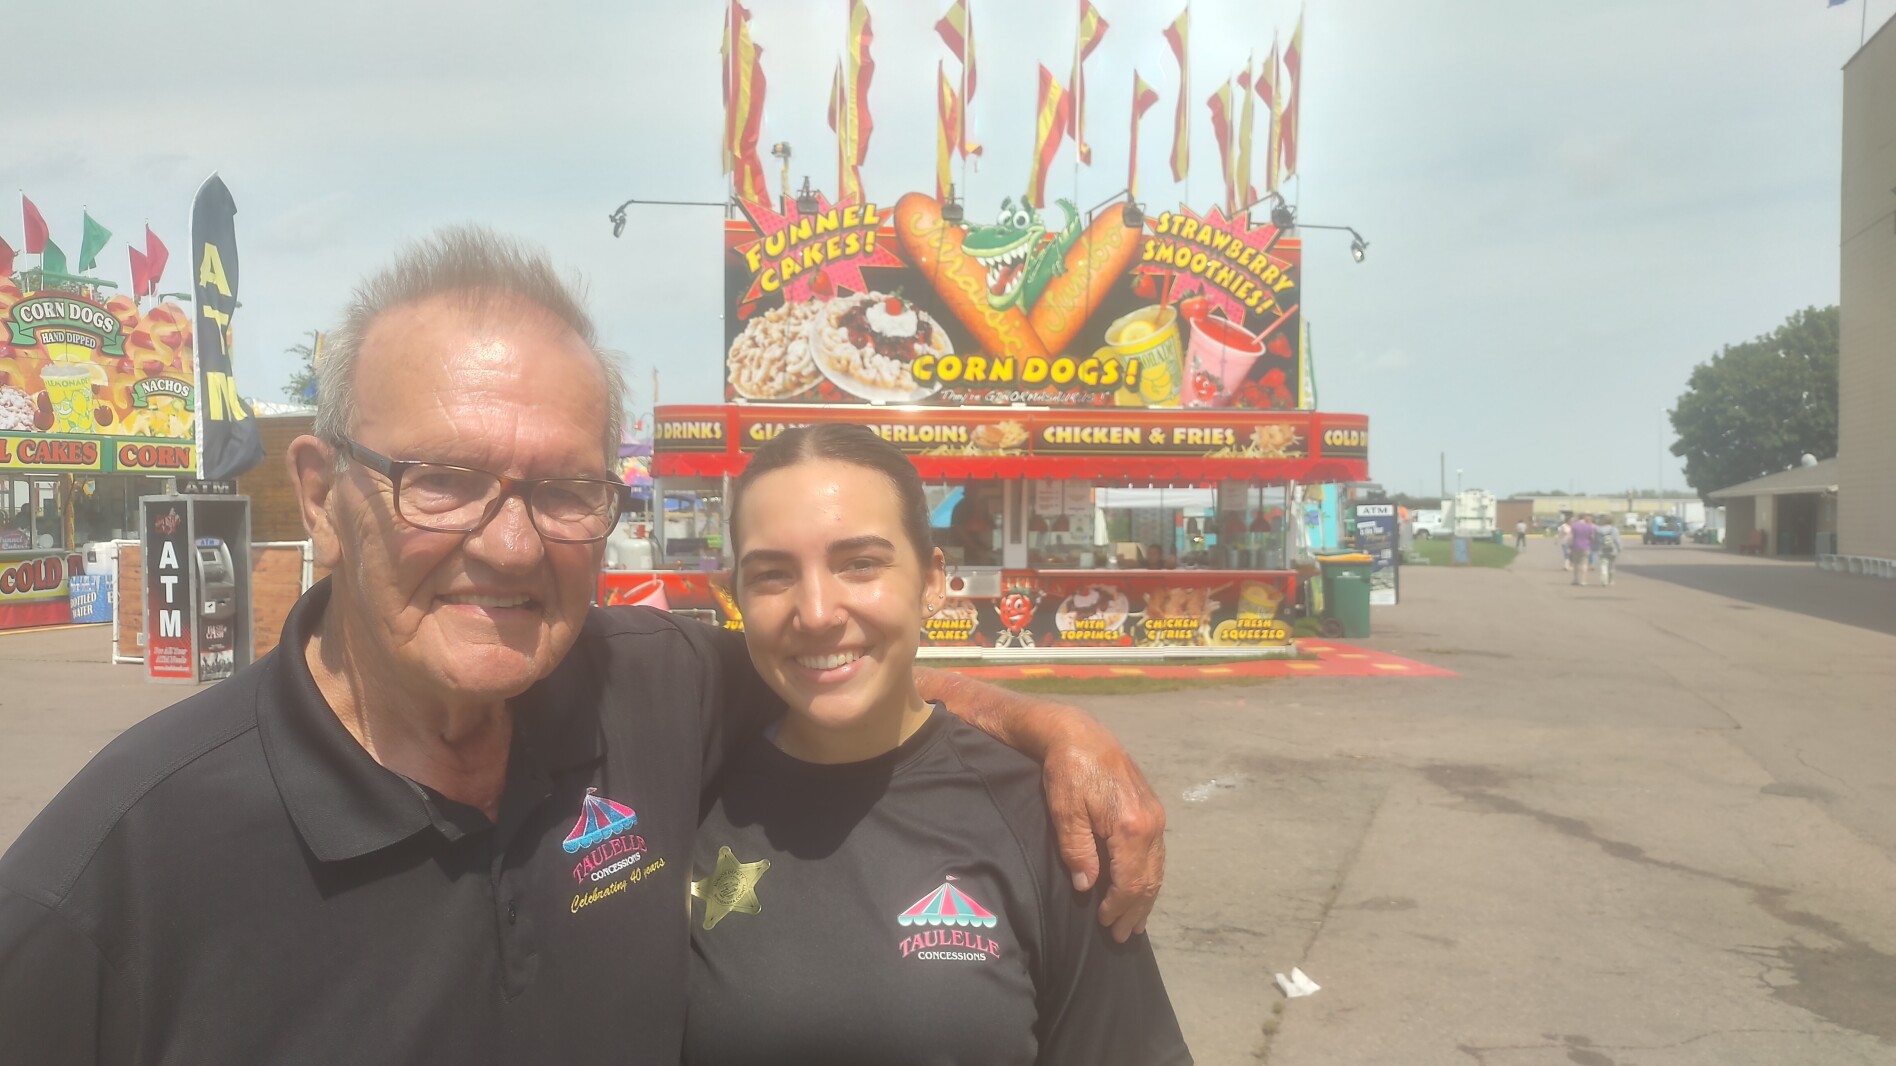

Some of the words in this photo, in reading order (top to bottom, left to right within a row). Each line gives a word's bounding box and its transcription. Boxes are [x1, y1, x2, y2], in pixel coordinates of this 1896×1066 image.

[746, 204, 881, 272] FUNNEL
[761, 231, 876, 291] CAKES!
[1156, 212, 1294, 293] STRAWBERRY
[1142, 240, 1274, 314] SMOOTHIES!
[20, 301, 64, 323] CORN
[69, 304, 114, 333] DOGS
[42, 332, 65, 344] HAND
[66, 333, 96, 349] DIPPED
[912, 355, 1014, 382] CORN
[1021, 357, 1139, 385] DOGS!
[142, 379, 190, 397] NACHOS
[664, 421, 722, 439] DRINKS
[1043, 426, 1141, 444] CHICKEN
[1149, 428, 1165, 444] &
[1173, 427, 1235, 445] FRIES
[1324, 429, 1359, 446] COLD
[17, 439, 98, 465] CAKES
[119, 444, 190, 468] CORN
[185, 480, 229, 492] ATM
[0, 556, 63, 594] COLD
[159, 541, 181, 638] ATM
[925, 619, 972, 628] FUNNEL
[1075, 619, 1105, 629] WITH
[1145, 619, 1198, 629] CHICKEN
[1237, 619, 1272, 628] FRESH
[928, 630, 968, 640] CAKES
[1061, 630, 1119, 641] TOPPINGS
[1221, 629, 1285, 640] SQUEEZED
[591, 852, 641, 881] CONCESSIONS
[570, 880, 628, 914] Celebrating
[630, 867, 642, 884] 40
[644, 857, 666, 879] years
[899, 929, 1000, 959] TAULELLE
[918, 951, 986, 961] CONCESSIONS
